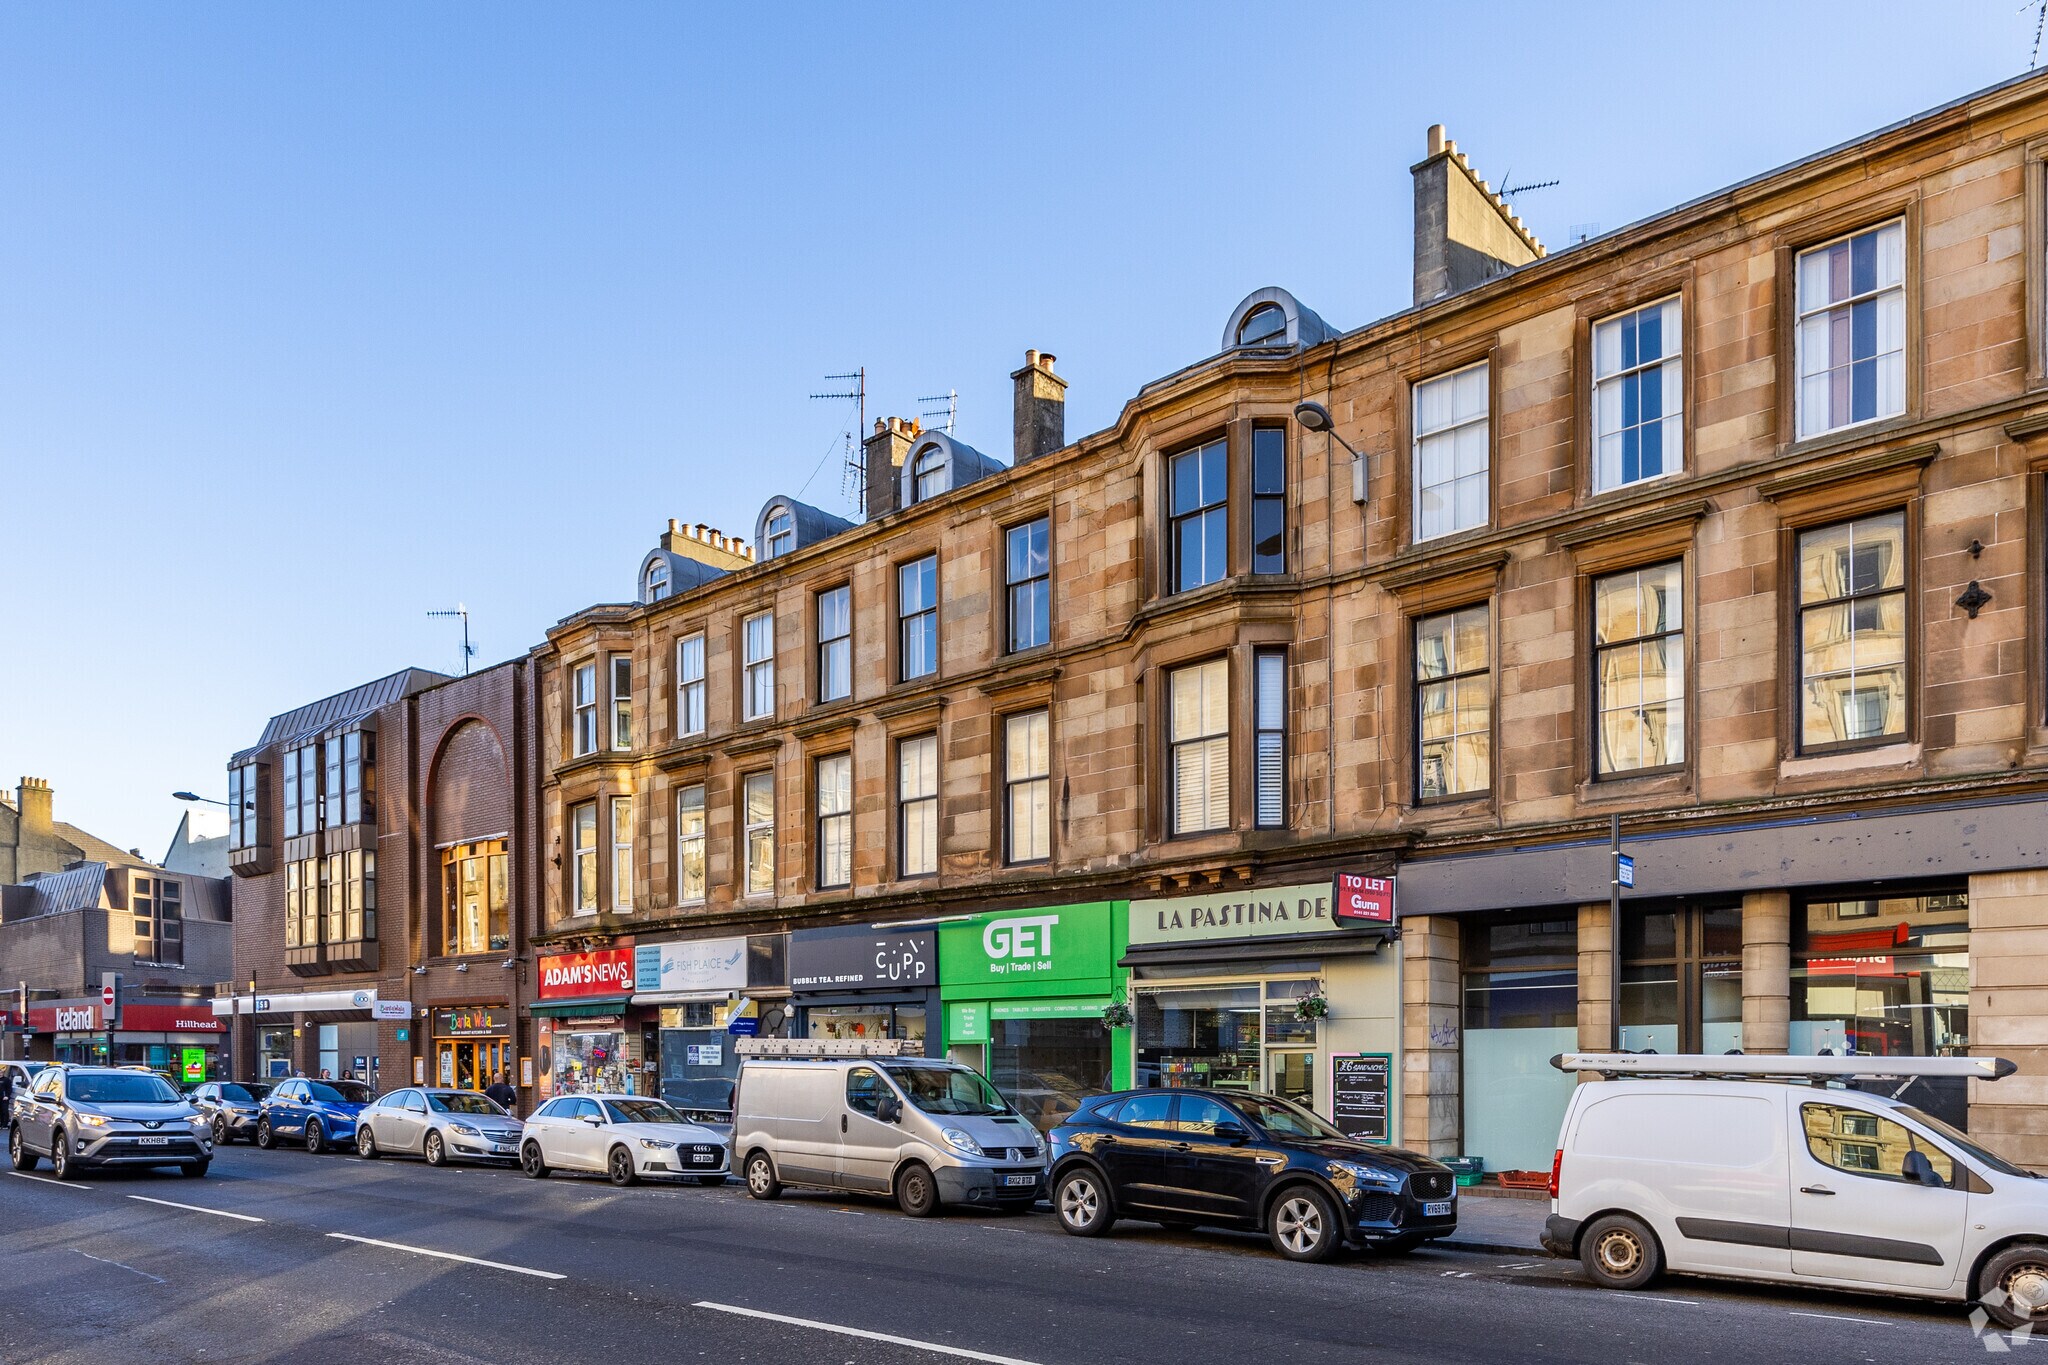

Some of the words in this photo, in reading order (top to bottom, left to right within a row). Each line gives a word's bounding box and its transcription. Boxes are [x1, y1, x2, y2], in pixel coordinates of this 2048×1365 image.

[1345, 875, 1362, 888] TO
[1365, 877, 1386, 891] LET
[1158, 910, 1184, 931] LA
[1190, 901, 1290, 929] PASTINA
[1298, 897, 1328, 919] DE
[983, 915, 1059, 959] GET
[677, 959, 693, 971] FISH
[694, 957, 721, 970] PLAICE
[990, 964, 1005, 974] Buy
[1011, 962, 1031, 972] Trade
[1037, 961, 1052, 970] Sell
[544, 965, 592, 986] ADAM'S
[592, 962, 628, 983] NEWS
[793, 977, 818, 985] BUBBLE
[835, 975, 863, 983] REFINED
[56, 1005, 94, 1031] Iceland
[176, 1020, 217, 1029] Hillhead
[450, 1013, 472, 1030] Banta
[473, 1009, 492, 1028] Wala
[1427, 1203, 1440, 1214] RV69
